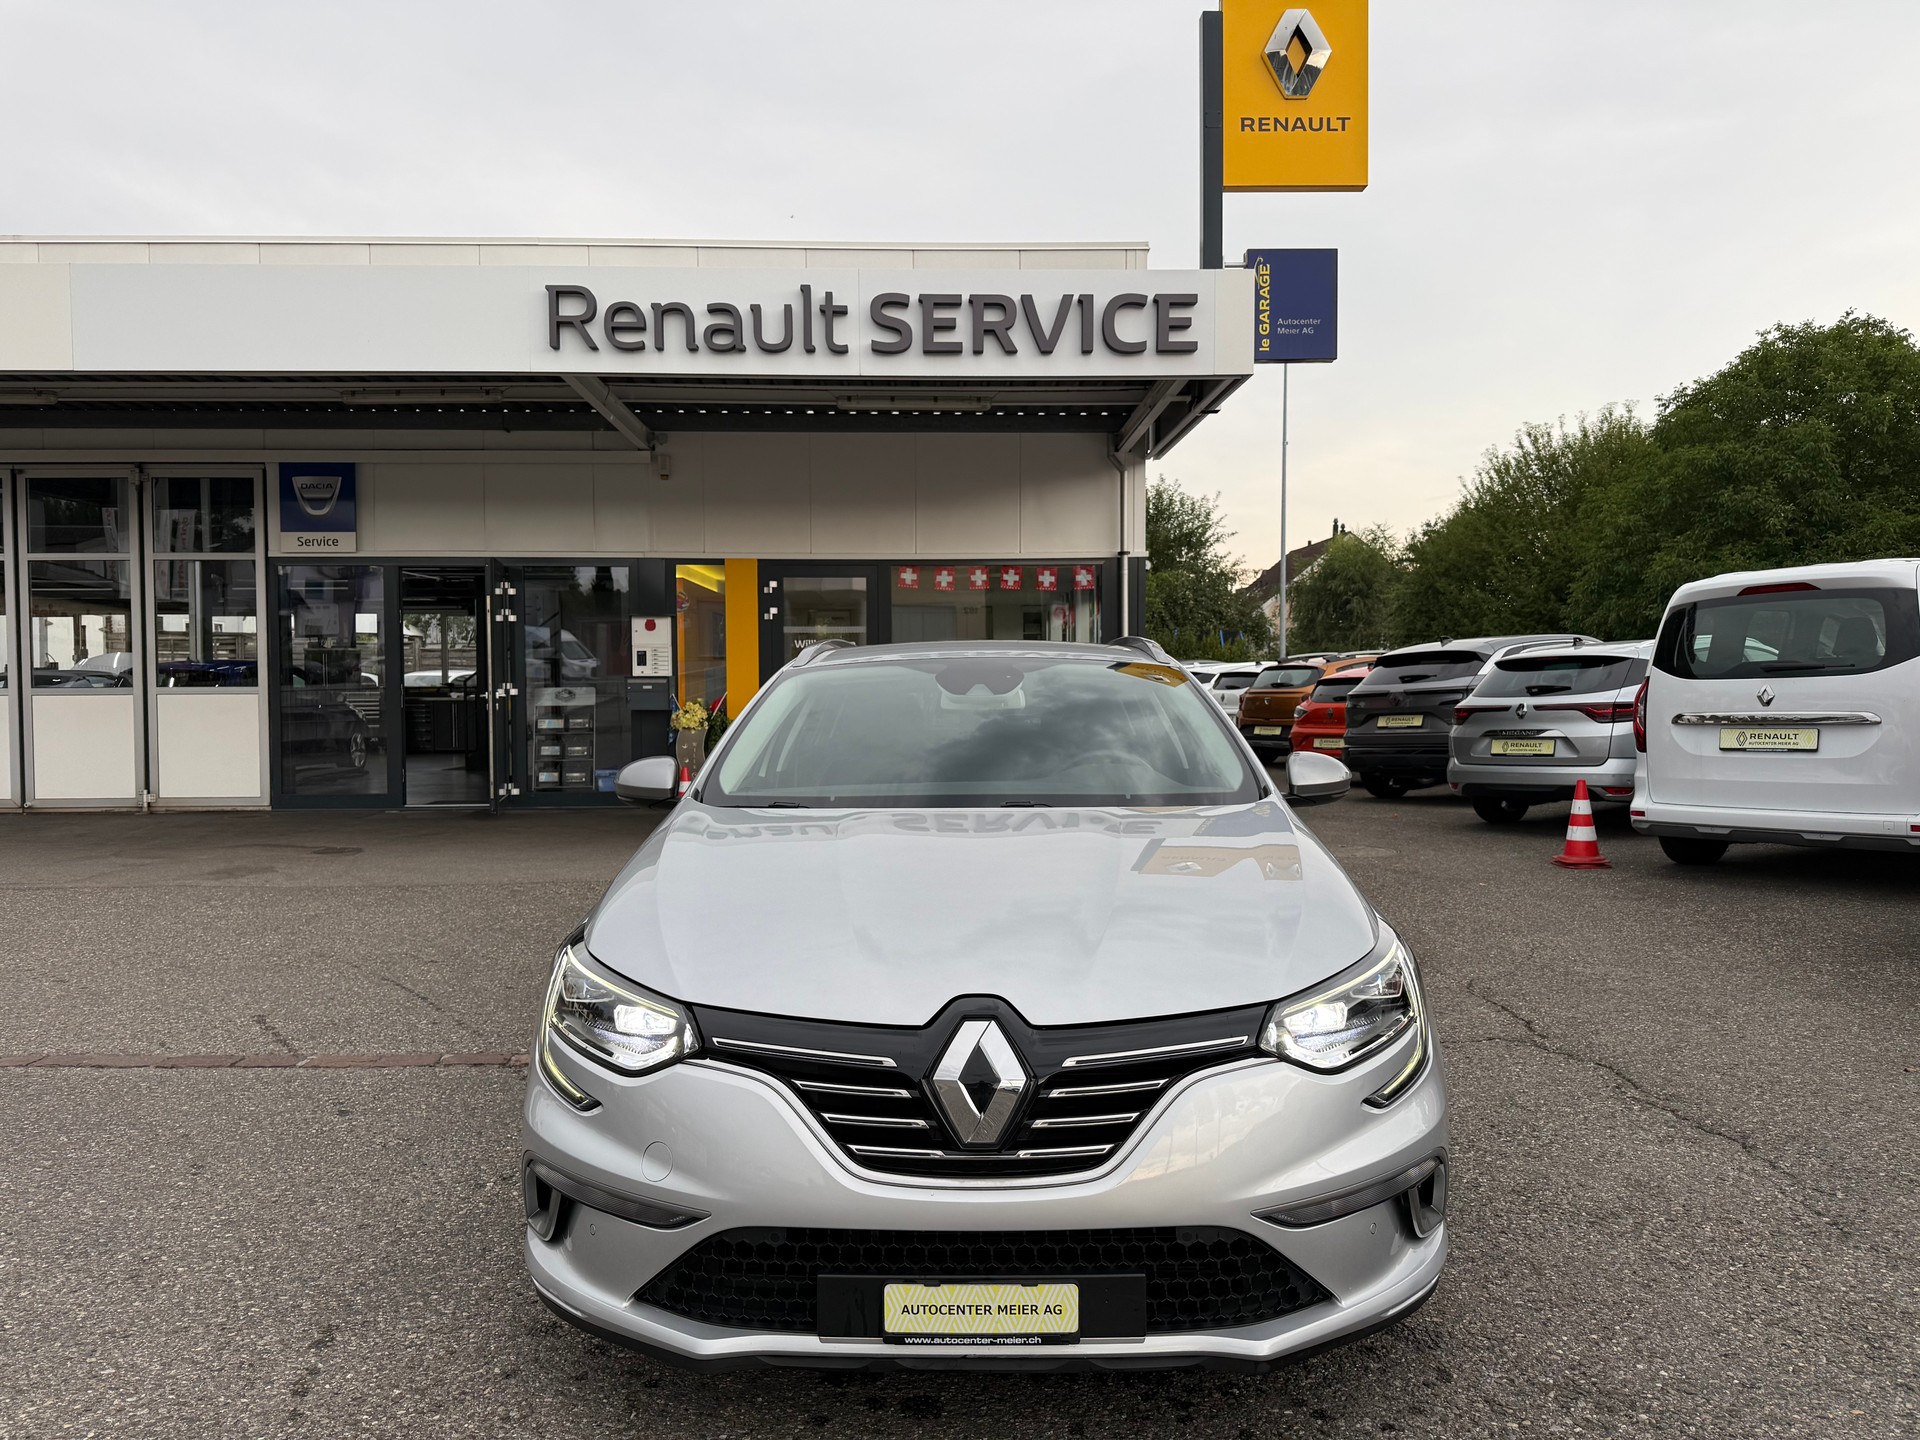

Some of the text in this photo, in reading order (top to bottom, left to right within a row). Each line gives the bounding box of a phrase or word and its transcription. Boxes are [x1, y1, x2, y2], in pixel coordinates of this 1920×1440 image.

[1240, 117, 1351, 132] RENAULT
[1259, 263, 1270, 352] le GARAGE
[544, 284, 1199, 355] Renault SERVICE
[297, 536, 339, 547] Service
[901, 1304, 1063, 1316] AUTOCENTER MEIER AG
[904, 1335, 1042, 1345] www.autocenter-meier.ch
